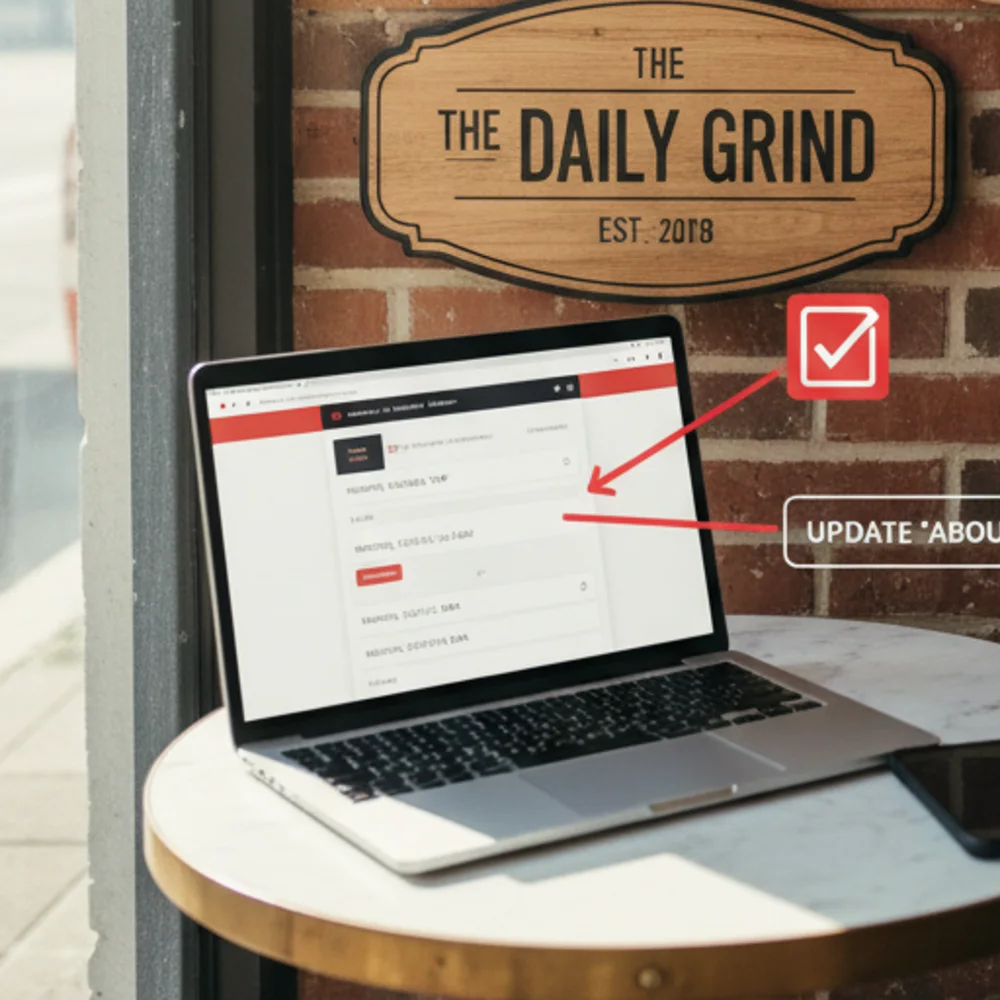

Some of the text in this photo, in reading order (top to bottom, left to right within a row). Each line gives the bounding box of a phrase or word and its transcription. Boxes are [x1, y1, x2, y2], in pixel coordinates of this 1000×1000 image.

[633, 46, 685, 80] THE
[438, 108, 875, 184] THE DAILY GRIND
